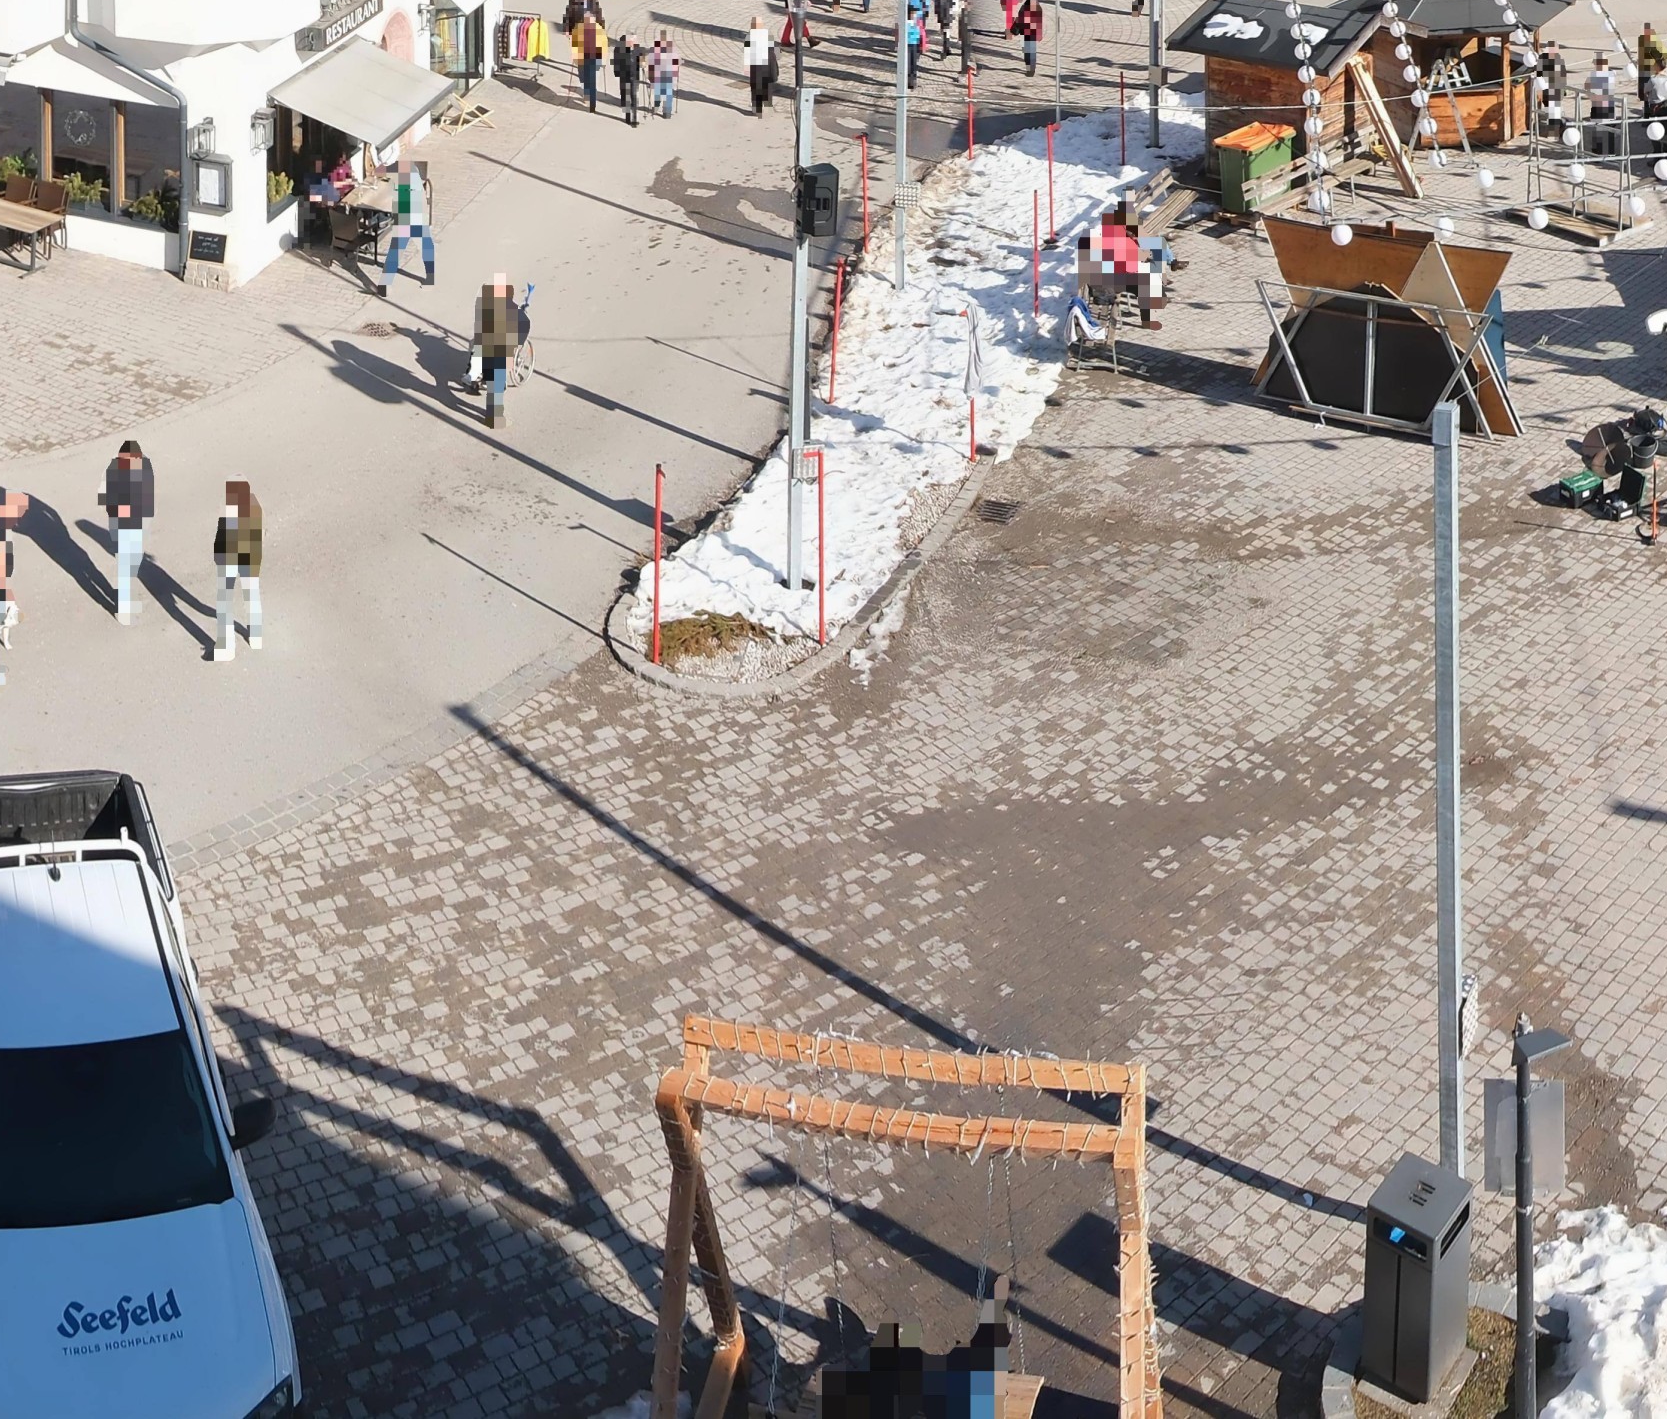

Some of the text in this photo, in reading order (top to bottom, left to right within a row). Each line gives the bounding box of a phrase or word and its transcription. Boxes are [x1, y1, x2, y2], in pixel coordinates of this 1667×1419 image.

[57, 1287, 182, 1339] Seefeld
[62, 1330, 184, 1356] TIROLS HOCHPLATEAU
